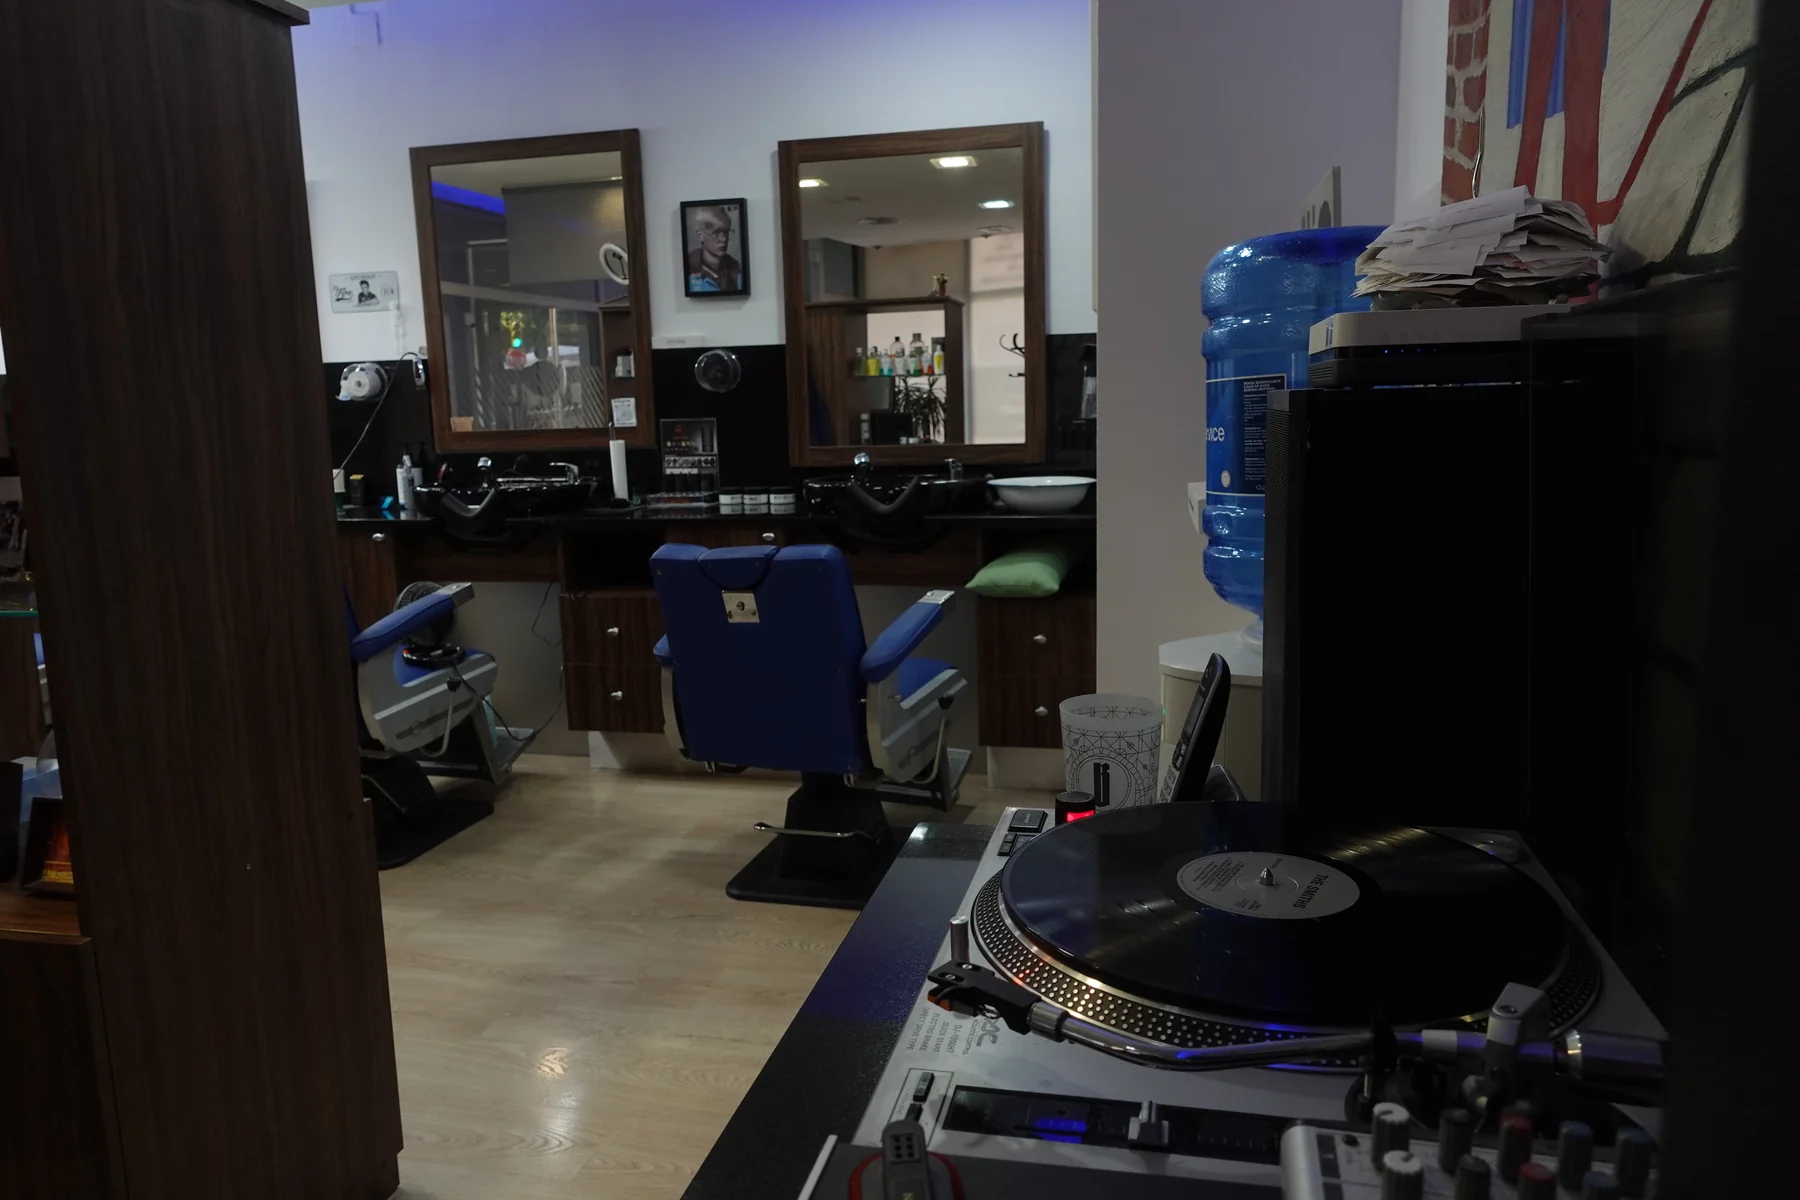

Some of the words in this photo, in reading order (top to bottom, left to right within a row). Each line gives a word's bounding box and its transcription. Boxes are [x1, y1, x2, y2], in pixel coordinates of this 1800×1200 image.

[1310, 875, 1329, 886] THE
[1292, 885, 1320, 909] SMITHS
[939, 1021, 950, 1037] QUICK
[906, 1037, 918, 1051] TYPE
[919, 1034, 932, 1052] BRAKE
[933, 1036, 945, 1053] START
